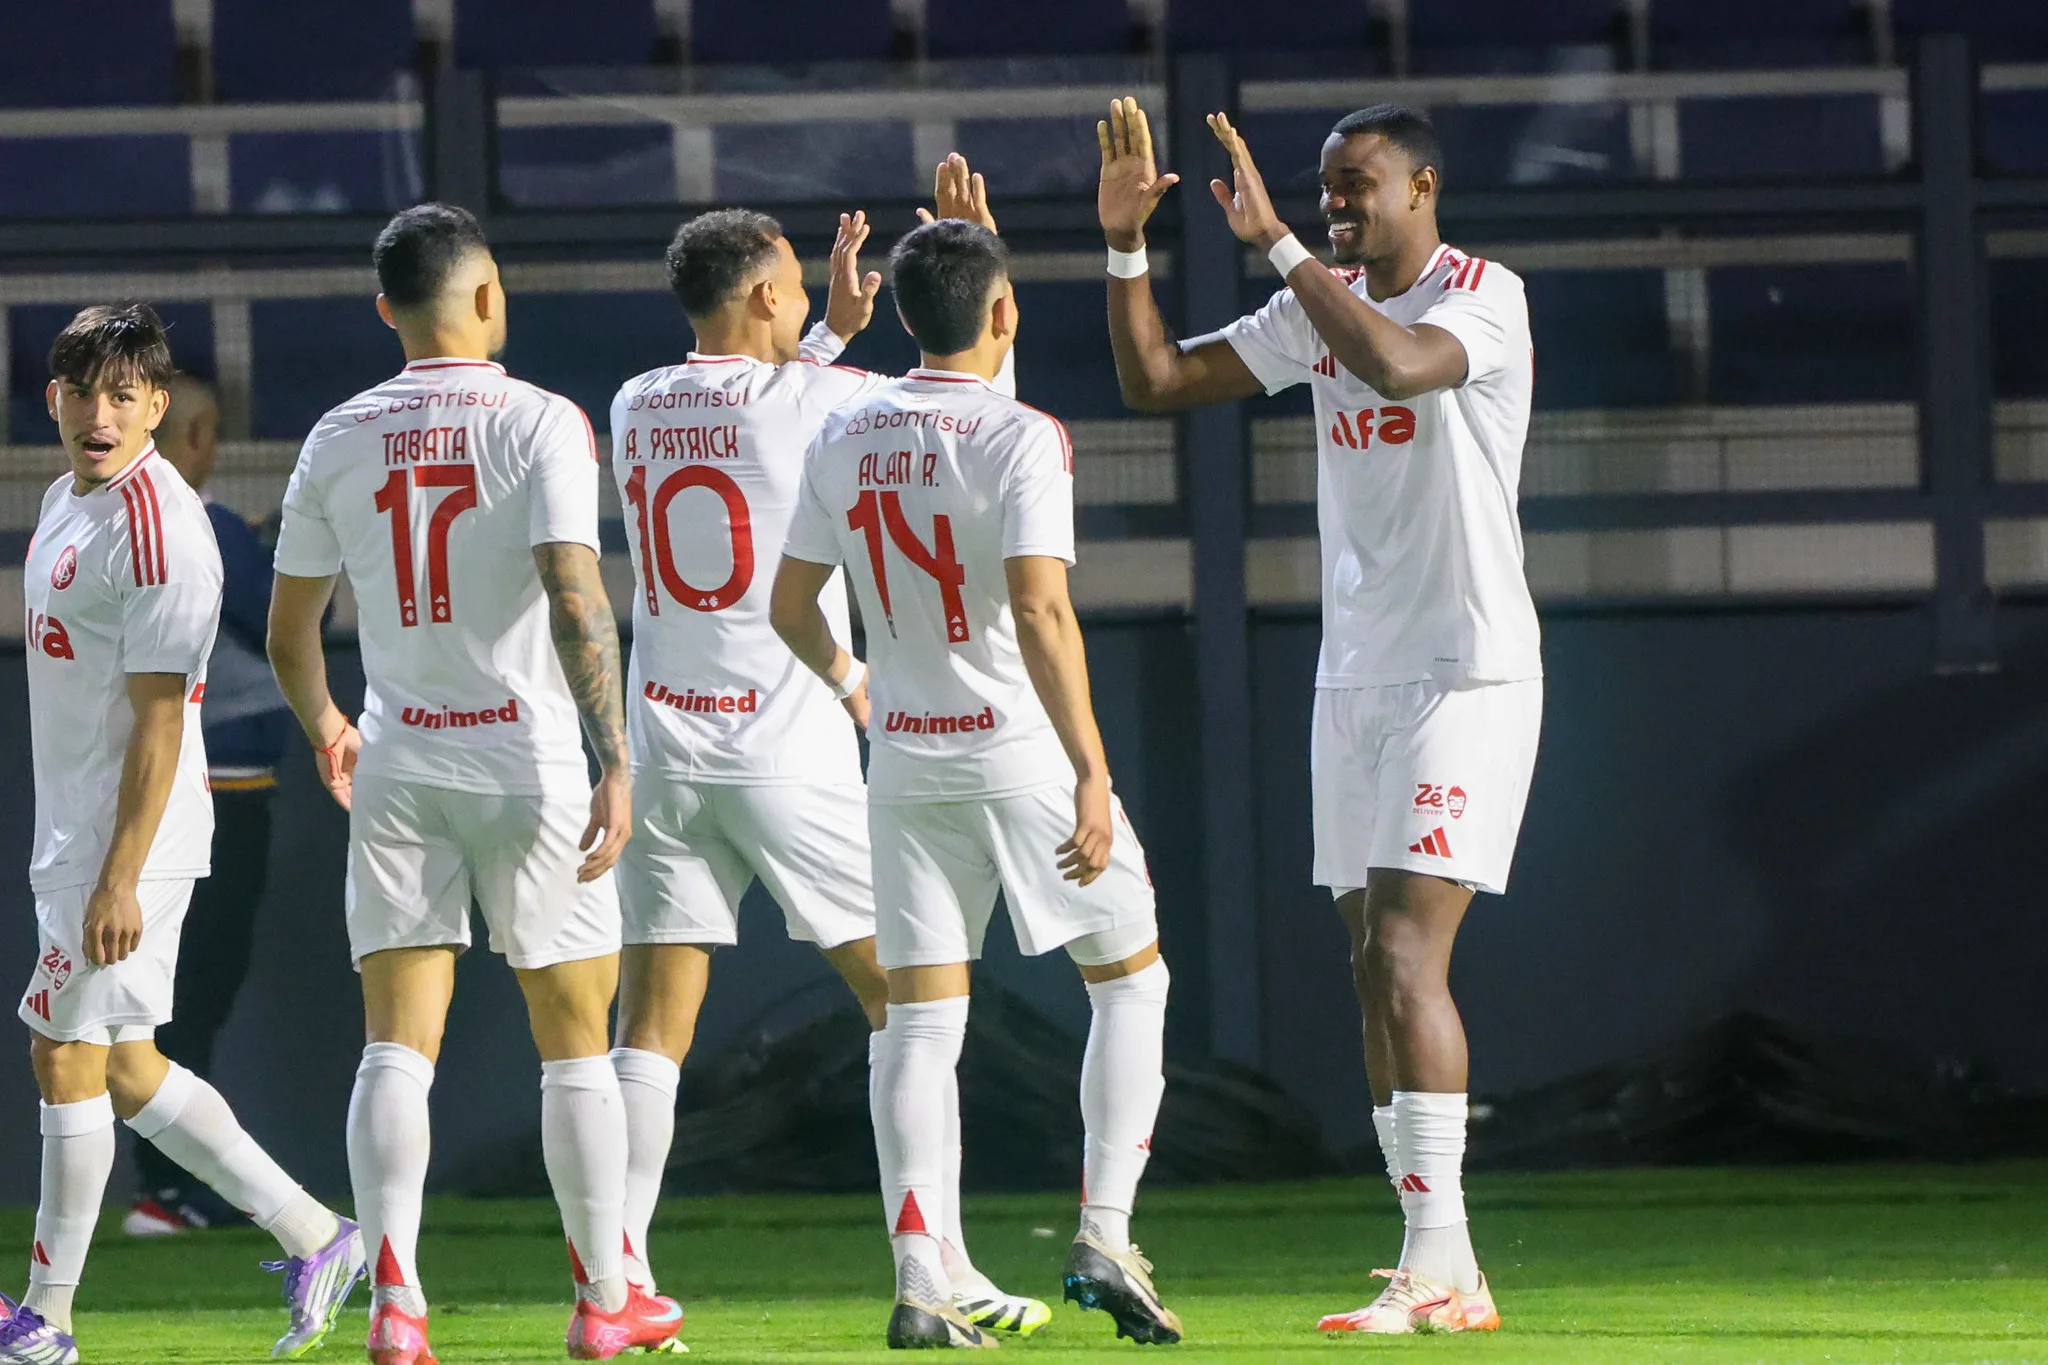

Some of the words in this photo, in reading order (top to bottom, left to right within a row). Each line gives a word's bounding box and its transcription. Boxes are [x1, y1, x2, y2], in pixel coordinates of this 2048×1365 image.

[388, 389, 508, 414] banrisul
[647, 387, 749, 410] banrisul
[873, 409, 982, 435] banrisul
[382, 426, 467, 466] TABATA
[625, 427, 642, 460] A.
[650, 424, 739, 460] PATRICK
[858, 450, 912, 486] ALAN
[922, 453, 940, 487] R.
[374, 463, 477, 628] 17
[624, 464, 755, 617] 10
[846, 489, 970, 643] 14
[28, 607, 75, 661] lfa
[401, 698, 519, 729] Unimed
[643, 680, 756, 713] Unimed
[885, 706, 995, 734] Unimed
[1414, 783, 1444, 808] Zé
